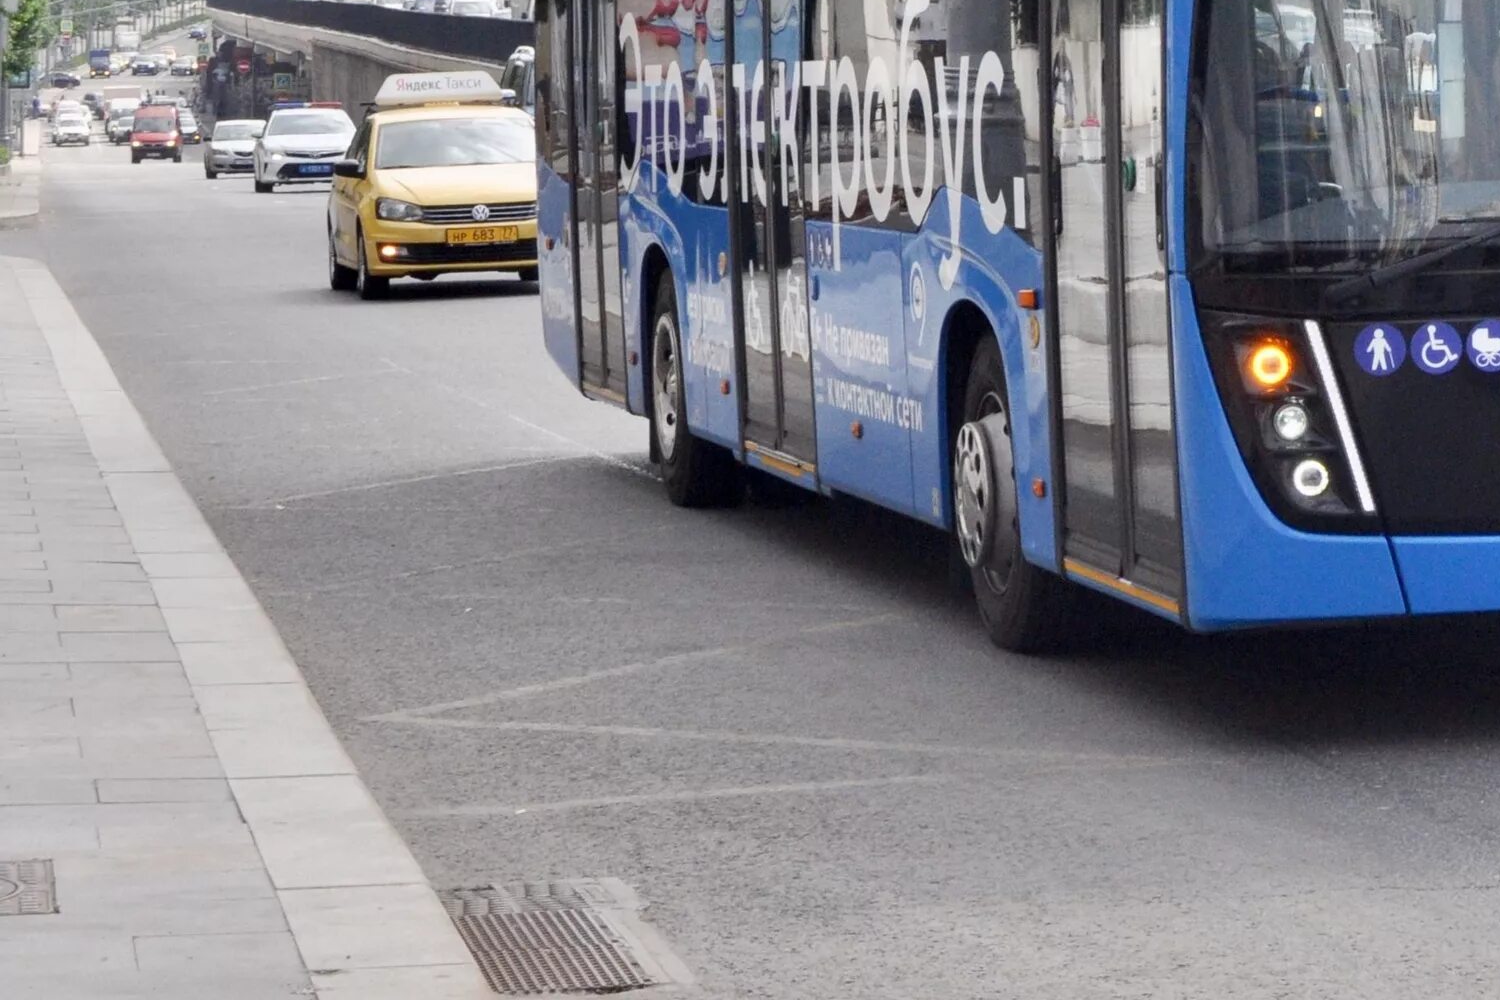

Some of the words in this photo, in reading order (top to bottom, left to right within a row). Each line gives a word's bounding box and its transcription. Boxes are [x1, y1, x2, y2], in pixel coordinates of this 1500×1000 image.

[396, 79, 441, 92] Яндекс
[445, 77, 482, 89] Такси
[617, 12, 686, 198] Это
[472, 229, 495, 241] 683
[896, 395, 923, 432] сети
